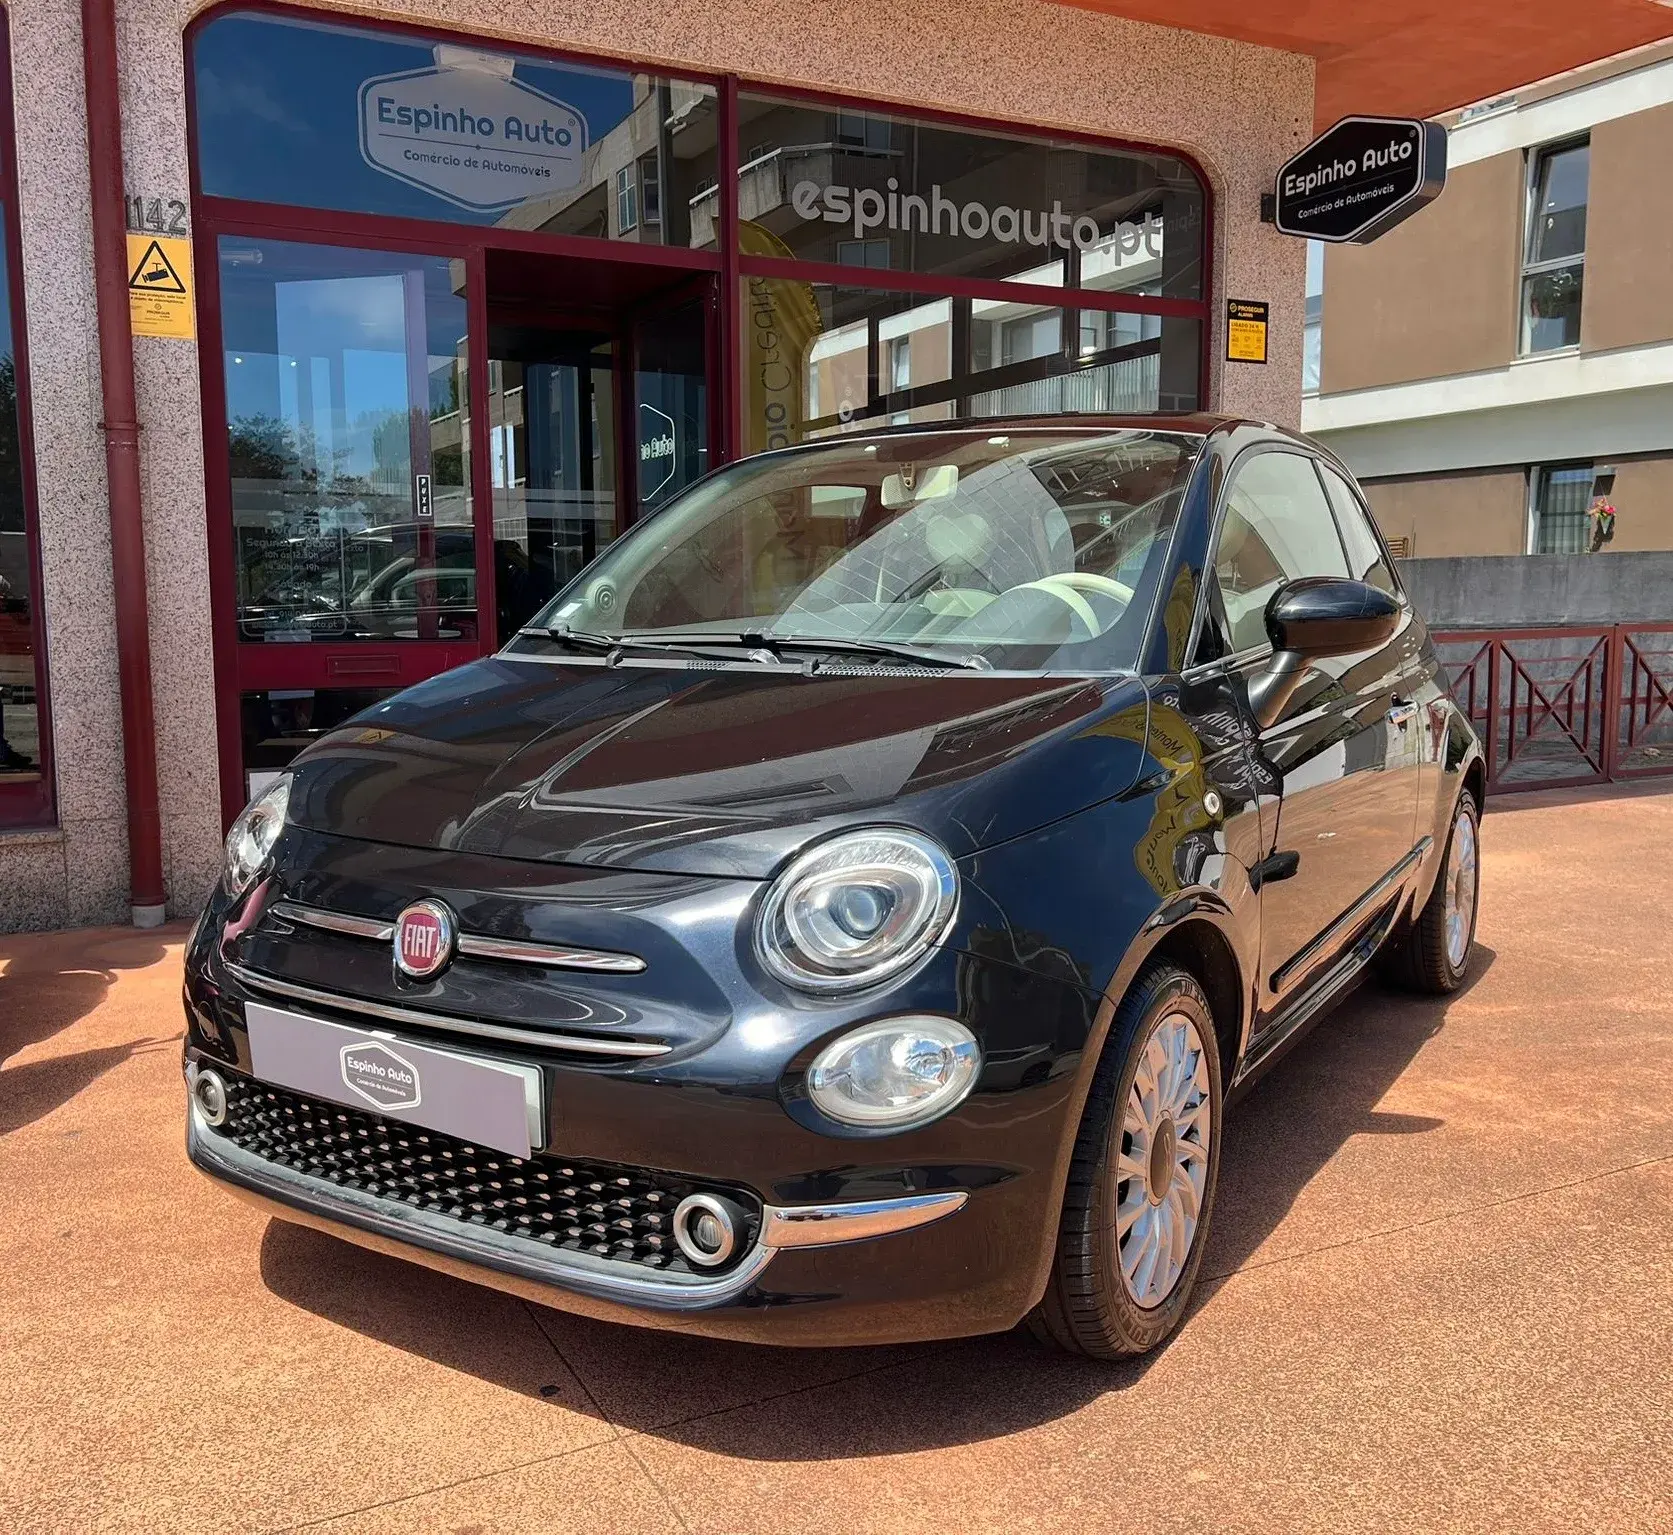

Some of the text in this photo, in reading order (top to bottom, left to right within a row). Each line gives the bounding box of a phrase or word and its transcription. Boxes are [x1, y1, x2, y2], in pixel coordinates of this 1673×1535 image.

[377, 96, 572, 147] Espinho Auto
[403, 149, 551, 178] Comércio de Automóveis
[1285, 140, 1413, 197] Espinho Auto
[125, 195, 187, 235] 1142
[1297, 182, 1395, 219] Comércio de Automóveis
[792, 176, 1164, 267] espinhoauto.pt
[651, 434, 673, 458] Auto
[404, 923, 437, 958] FIAT
[347, 1055, 412, 1084] Espinho Auto
